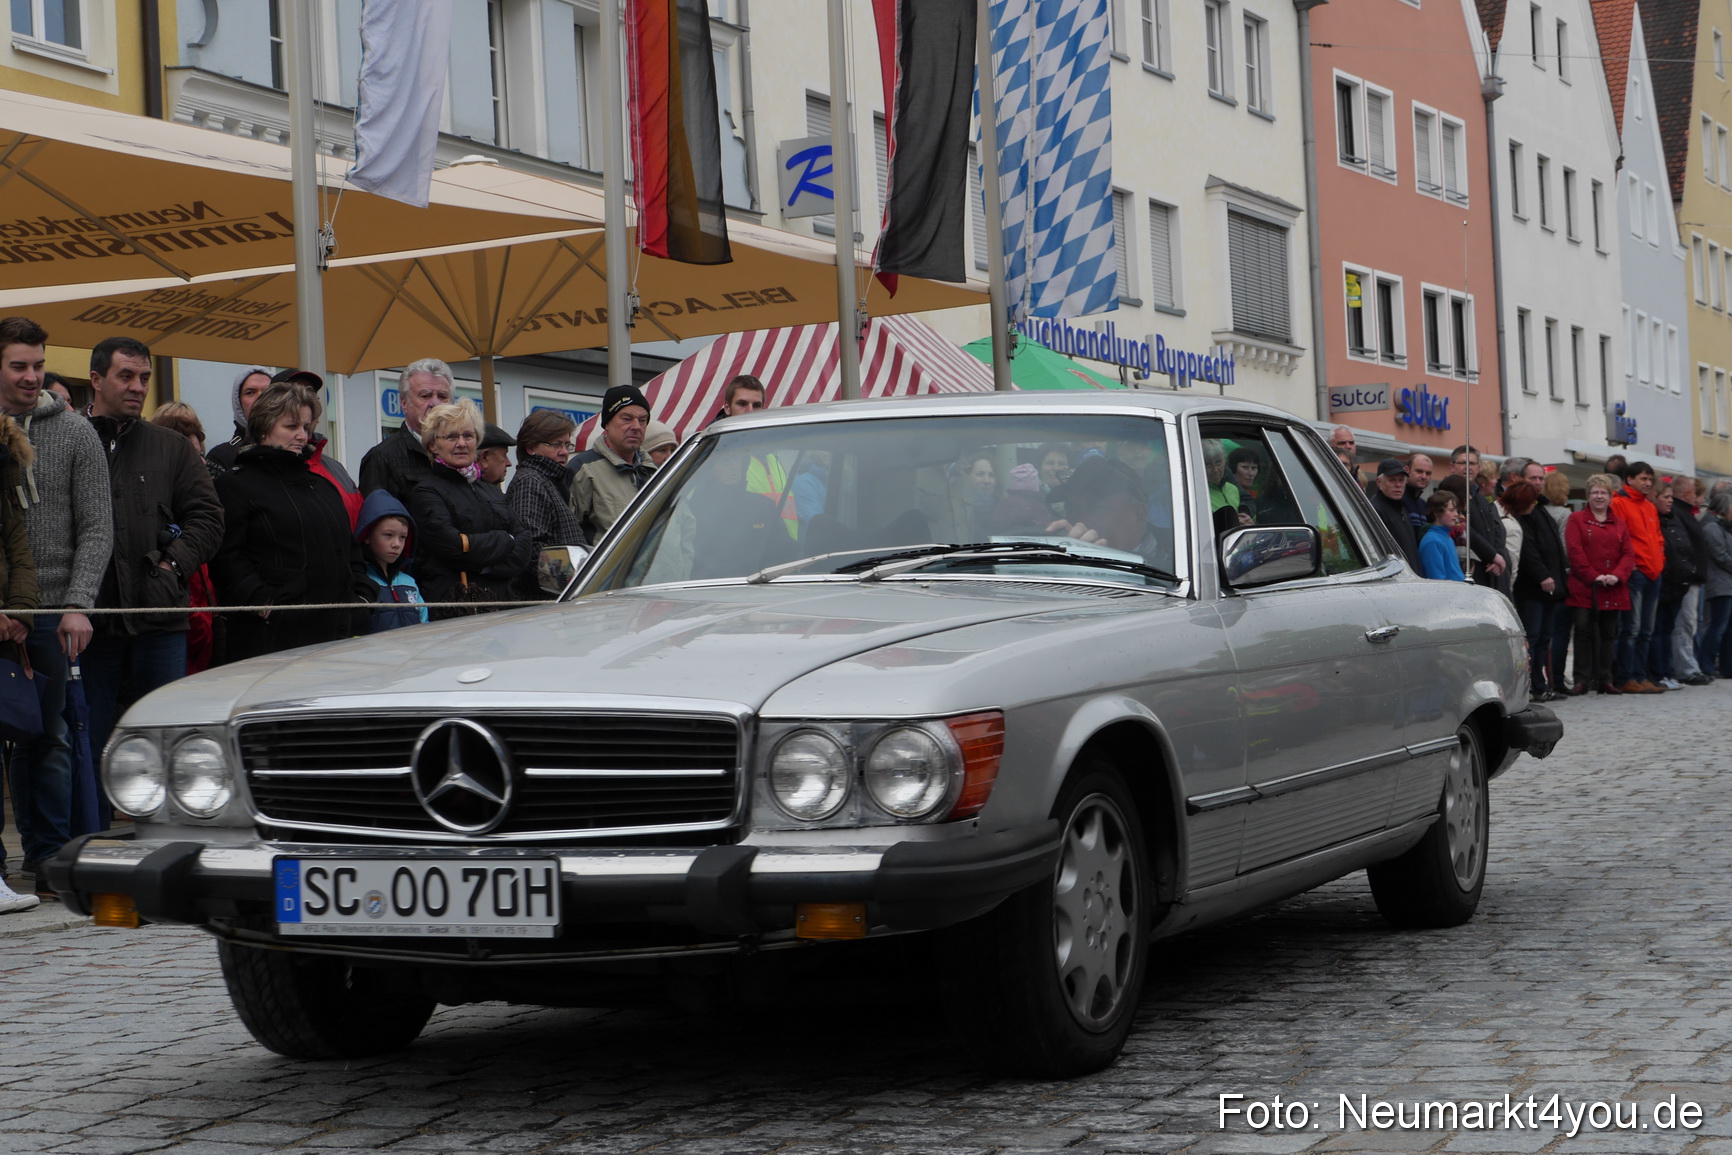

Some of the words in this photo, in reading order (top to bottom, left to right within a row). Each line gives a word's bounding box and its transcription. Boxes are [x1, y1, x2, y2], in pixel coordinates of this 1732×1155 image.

[1155, 333, 1235, 388] Rupprecht
[283, 898, 295, 911] D
[304, 866, 360, 916] SC
